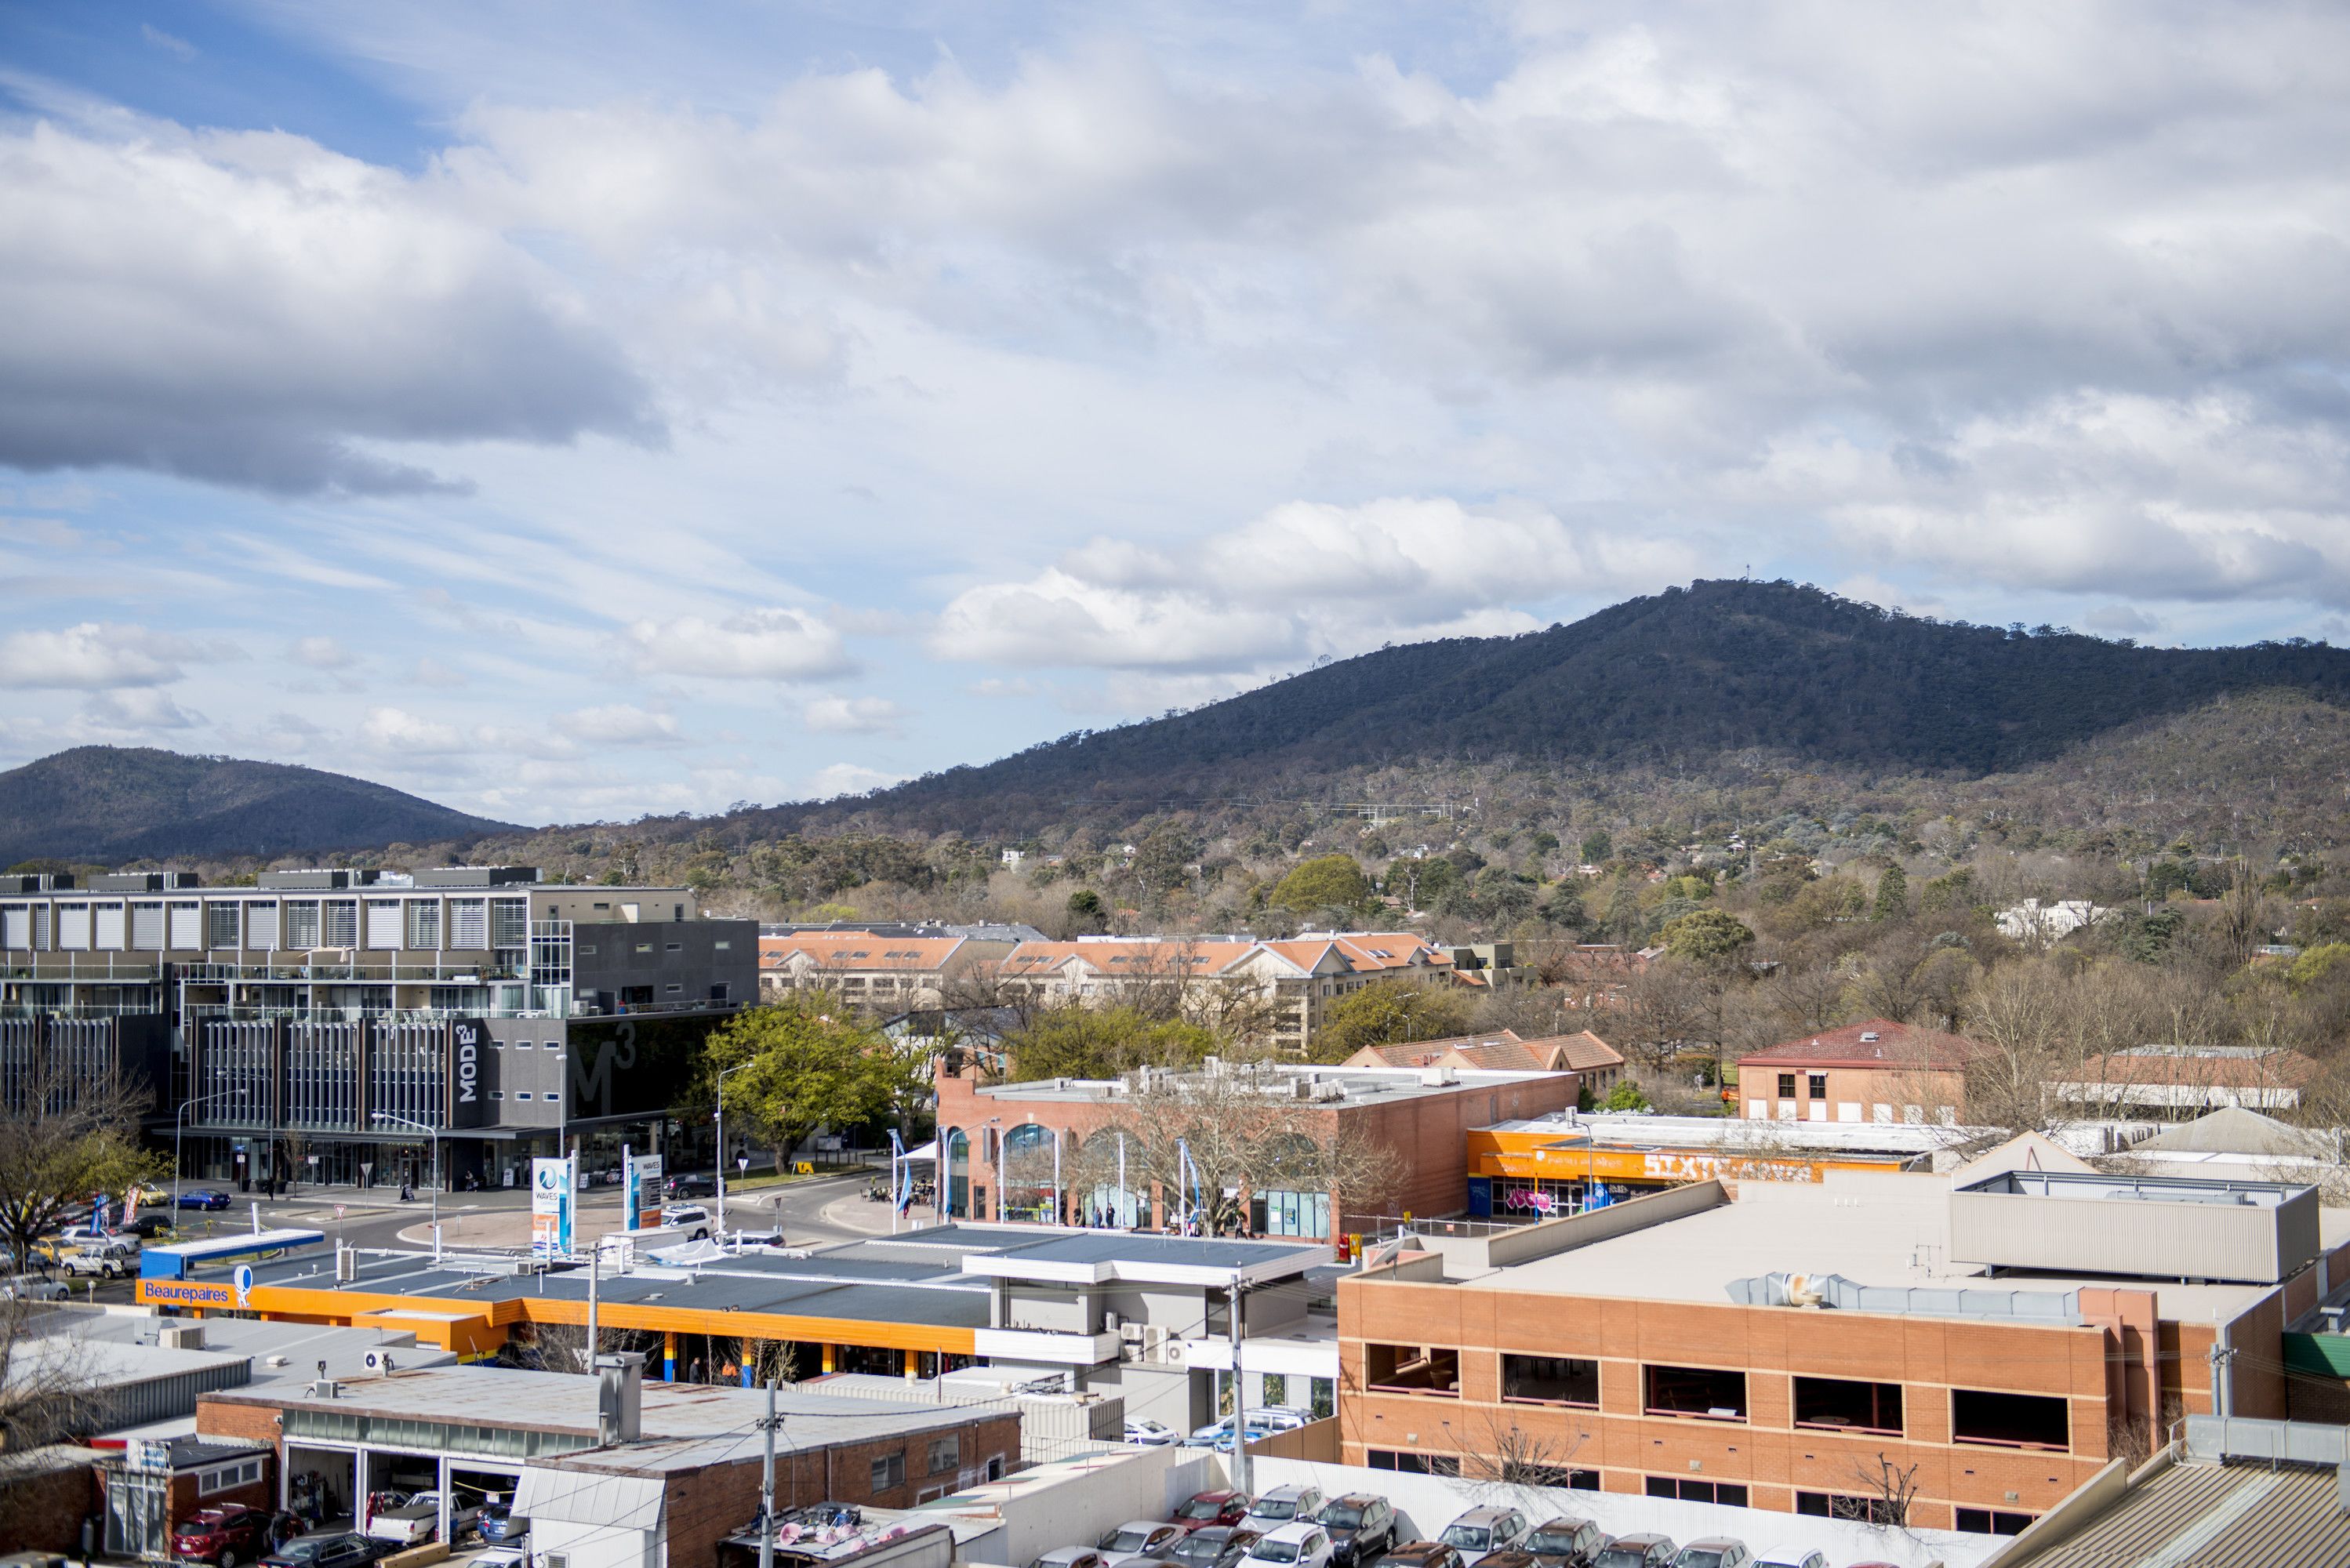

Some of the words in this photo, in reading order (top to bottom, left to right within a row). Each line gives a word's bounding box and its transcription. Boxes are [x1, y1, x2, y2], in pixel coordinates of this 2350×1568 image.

[642, 1161, 660, 1171] WAVES
[536, 1192, 558, 1201] WAVES
[145, 1282, 228, 1304] Beaurepaires
